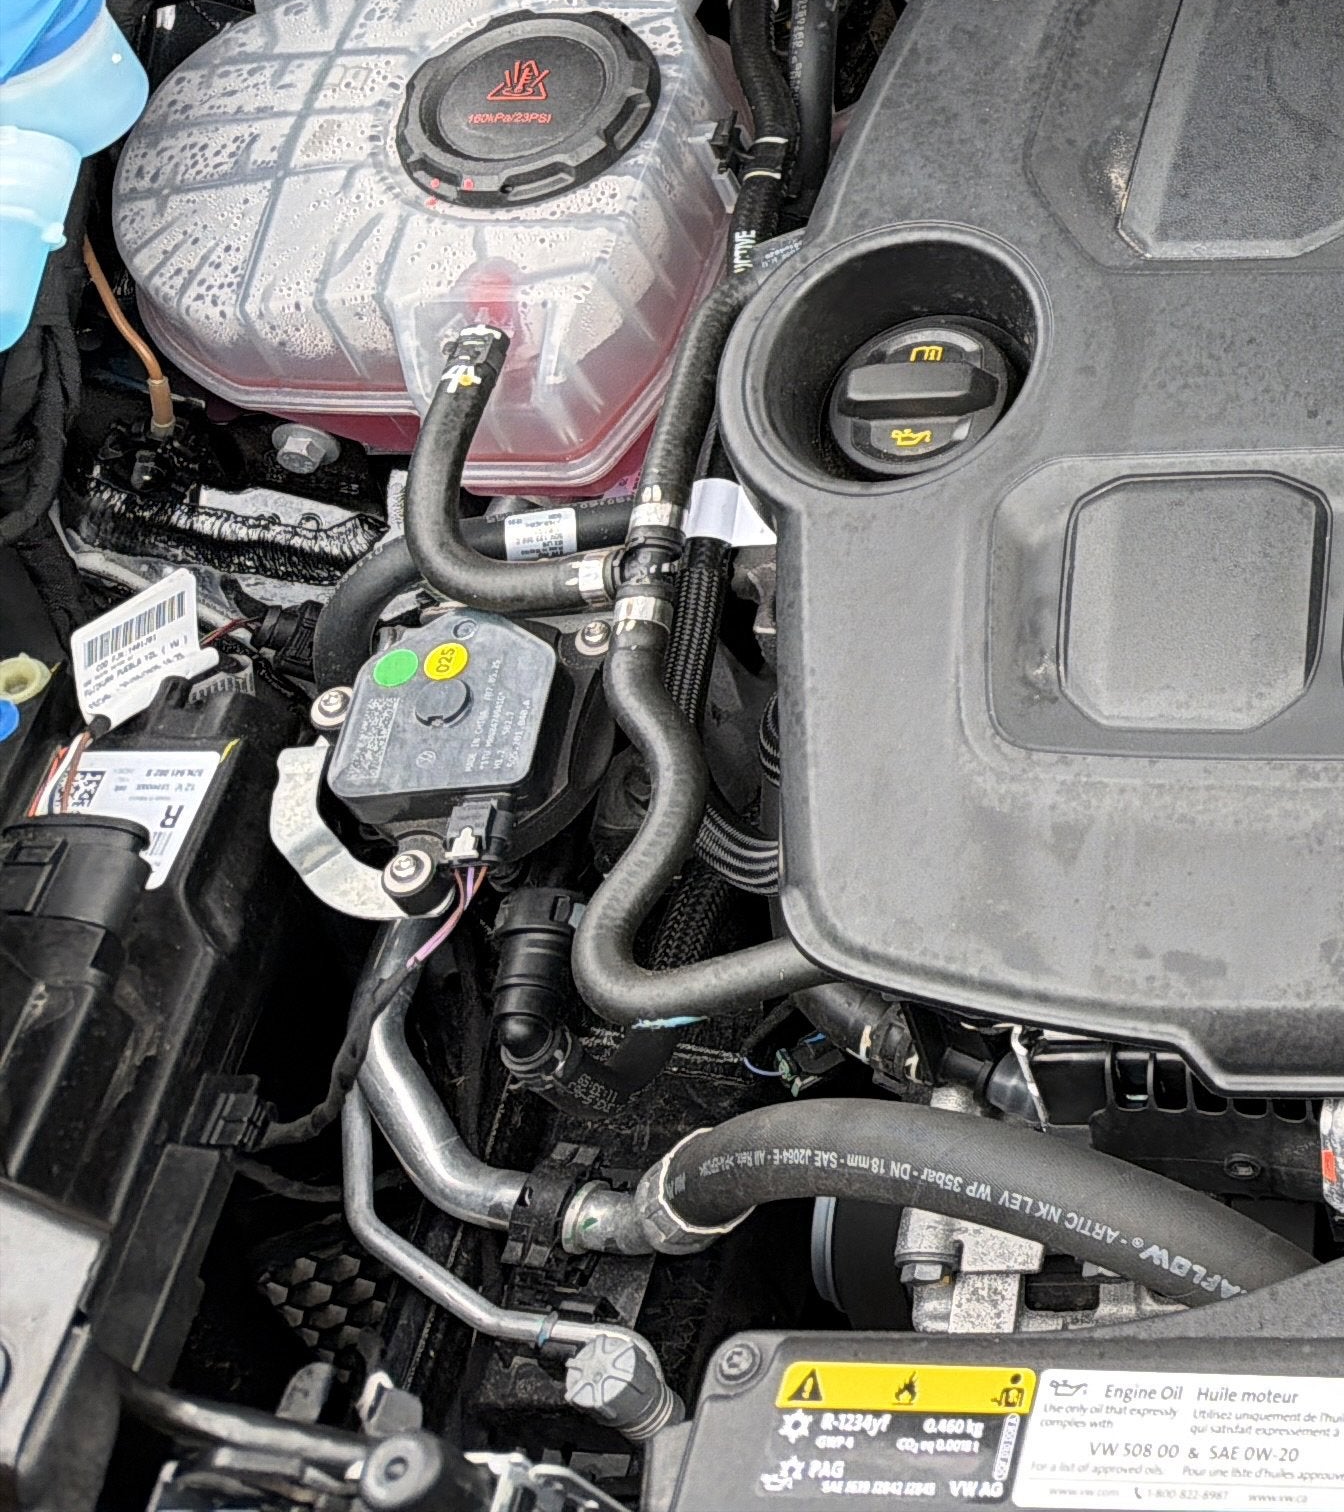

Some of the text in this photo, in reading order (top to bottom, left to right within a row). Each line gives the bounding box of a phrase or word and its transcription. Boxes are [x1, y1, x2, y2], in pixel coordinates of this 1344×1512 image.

[159, 805, 184, 829] R
[814, 1149, 838, 1169] SAE
[889, 1160, 911, 1178] DN
[920, 1166, 962, 1192] 35bar
[964, 1179, 992, 1203] WP
[999, 1189, 1032, 1213] LEV
[1033, 1198, 1062, 1225] NK
[1064, 1210, 1121, 1245] ARTIC
[1105, 1385, 1299, 1405] Engine Oil Huile moteur
[1065, 1404, 1088, 1418] only
[1105, 1405, 1127, 1417] that
[1234, 1410, 1301, 1424] uniquement
[1303, 1412, 1316, 1423] de
[1089, 1441, 1299, 1462] VW 508 00 & SAE 0W-20
[808, 1460, 844, 1479] PAG
[1092, 1463, 1142, 1477] approved
[949, 1481, 978, 1496] VW
[979, 1482, 1004, 1498] AG
